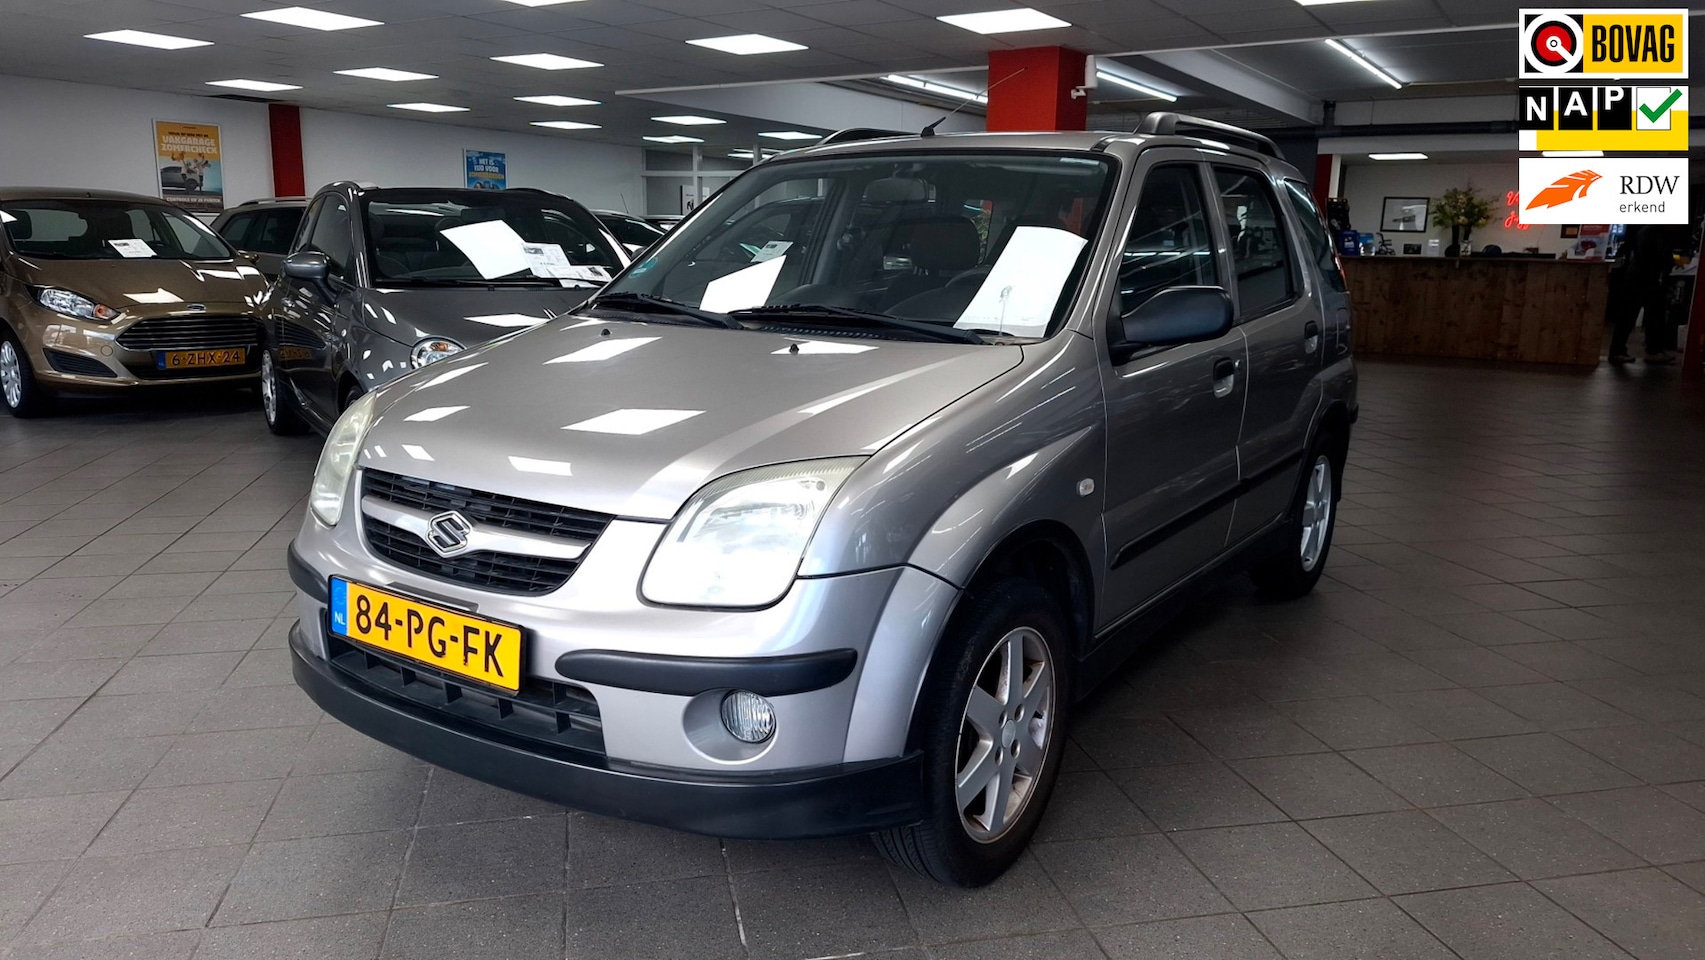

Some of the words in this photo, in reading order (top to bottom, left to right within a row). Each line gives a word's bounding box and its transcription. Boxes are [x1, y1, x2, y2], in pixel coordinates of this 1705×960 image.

[162, 136, 215, 147] VAKGARAGE
[161, 144, 217, 154] ZOMERCHECK
[172, 352, 240, 366] 6-ZHX-24
[334, 611, 346, 626] NL
[355, 594, 504, 678] 84-PG-FK
